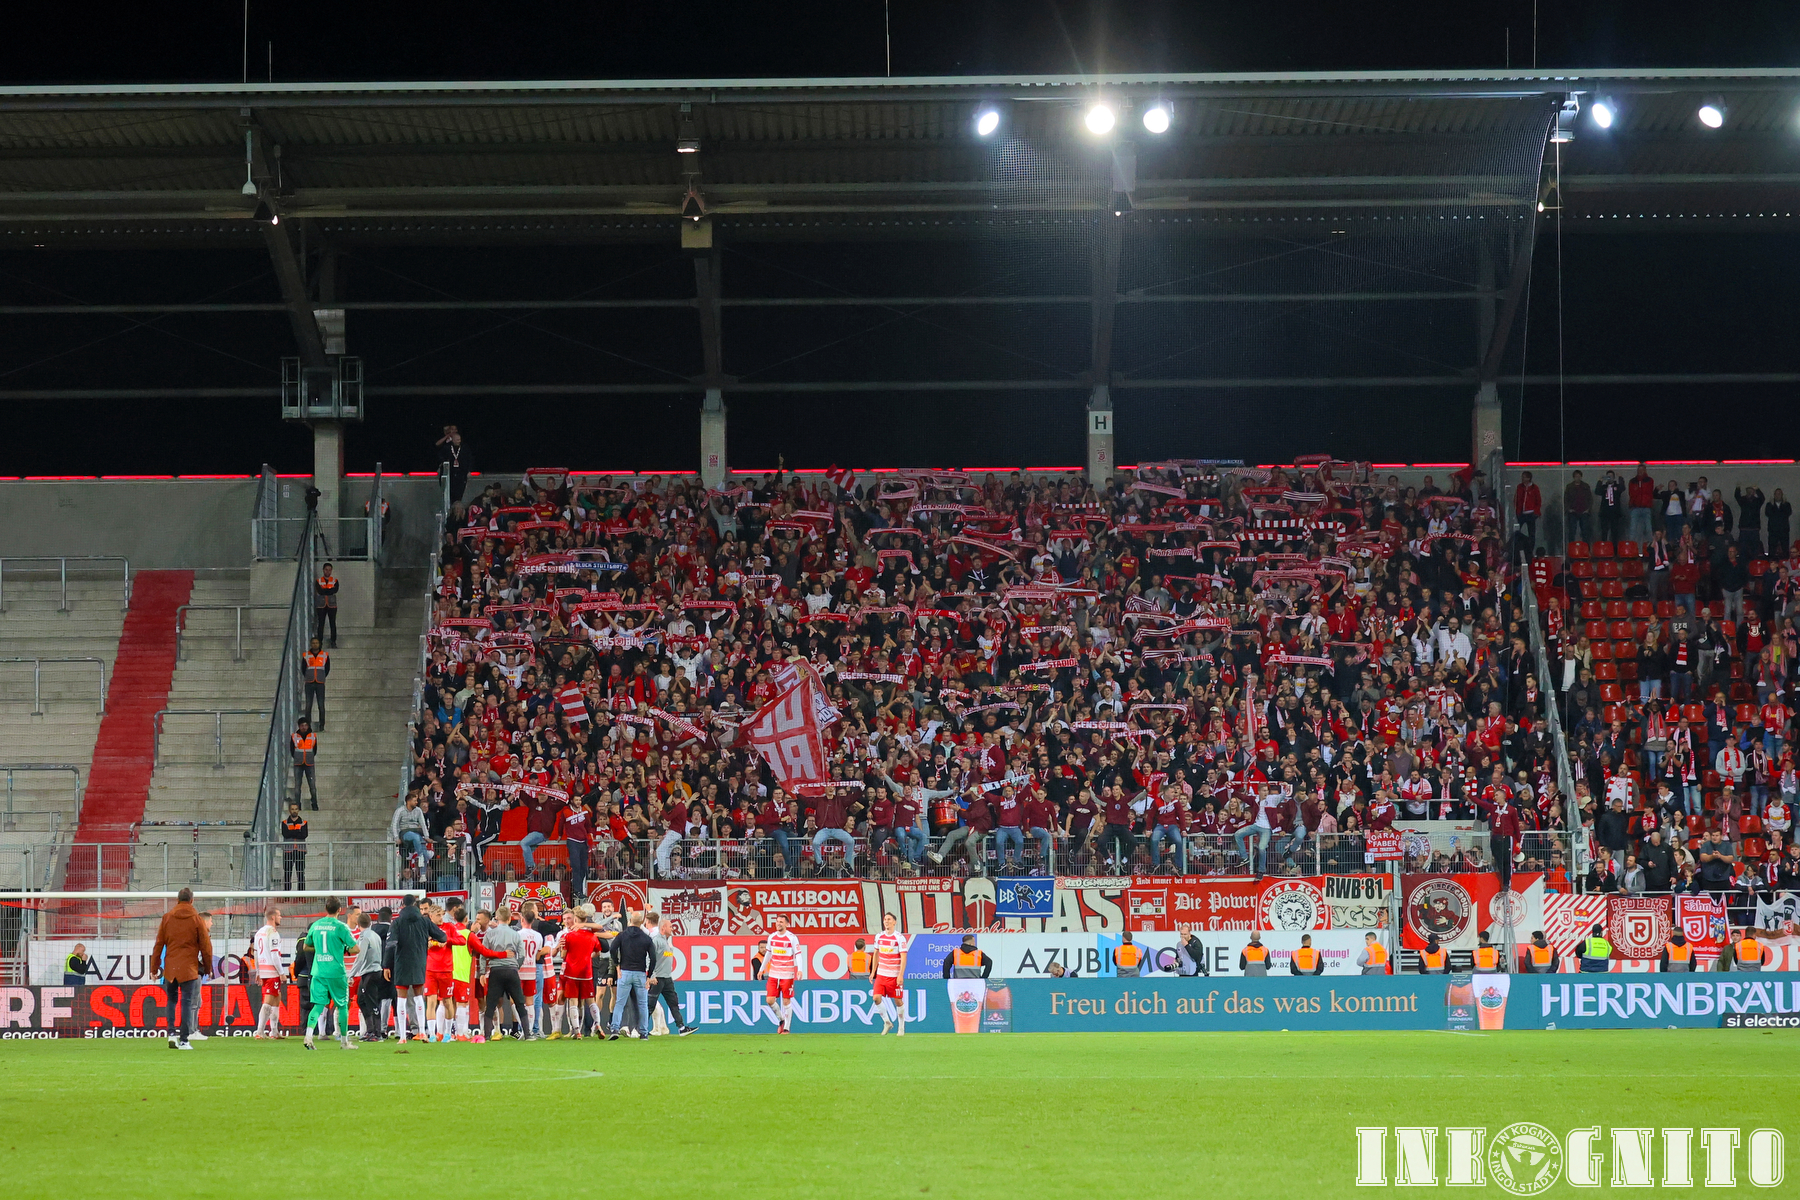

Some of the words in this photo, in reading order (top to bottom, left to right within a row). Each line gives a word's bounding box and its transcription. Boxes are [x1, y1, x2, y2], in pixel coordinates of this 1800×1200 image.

[1095, 416, 1107, 430] H
[1152, 876, 1172, 885] immer
[1174, 876, 1183, 885] bei
[1185, 877, 1197, 885] uns
[481, 888, 493, 897] 42
[755, 890, 860, 906] RATISBONA
[1173, 892, 1202, 911] Die
[1207, 891, 1257, 912] Power
[1611, 898, 1636, 910] RED
[1637, 897, 1669, 910] BOYS
[766, 912, 860, 928] FNATICA
[320, 930, 328, 954] 1
[522, 940, 537, 958] 10
[1629, 946, 1653, 958] 1889
[1049, 992, 1107, 1015] Freu
[1114, 991, 1168, 1015] dich
[1176, 990, 1219, 1014] auf
[1223, 990, 1265, 1014] das
[1273, 995, 1321, 1013] was
[1329, 990, 1419, 1013] kommt
[1541, 980, 1800, 1020] HERRNBRÄU
[1726, 1014, 1741, 1028] si
[1744, 1014, 1800, 1028] electro
[102, 1026, 168, 1039] electron
